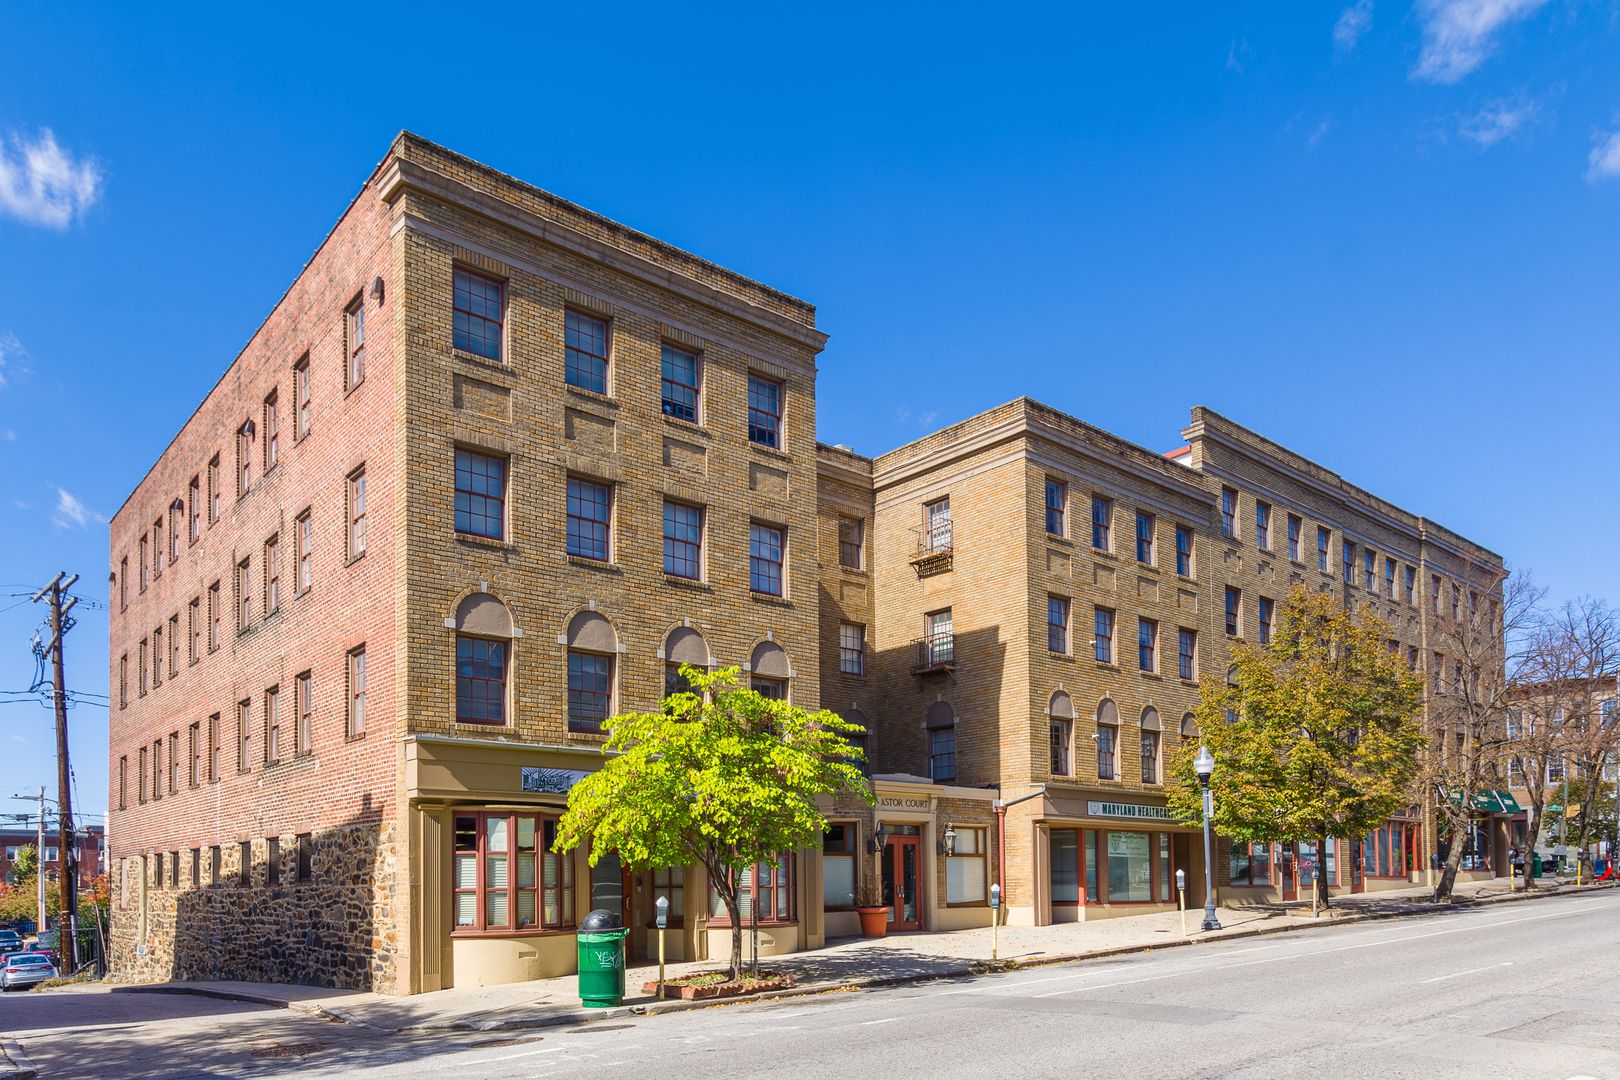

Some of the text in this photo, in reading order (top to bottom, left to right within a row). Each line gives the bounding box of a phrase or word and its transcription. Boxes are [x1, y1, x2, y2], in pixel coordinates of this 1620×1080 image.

[880, 798, 928, 808] ASTOR COURT
[1102, 804, 1136, 816] MARYLAND
